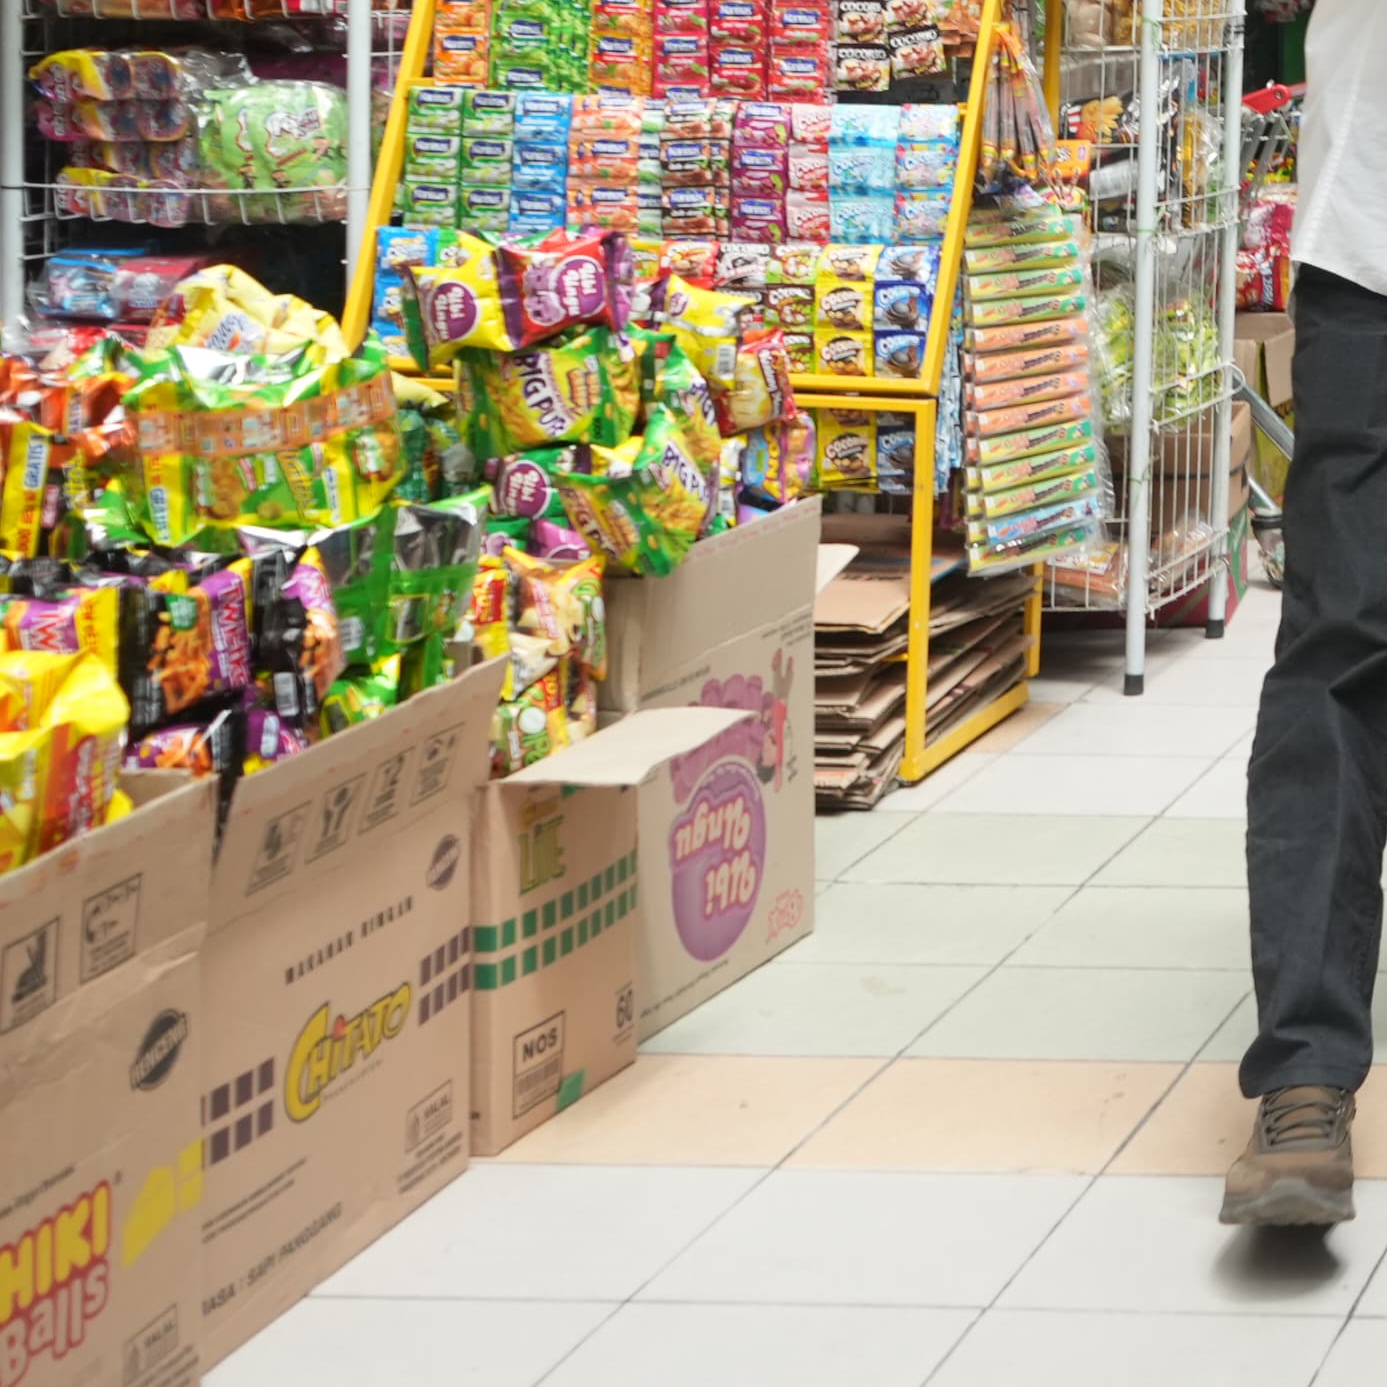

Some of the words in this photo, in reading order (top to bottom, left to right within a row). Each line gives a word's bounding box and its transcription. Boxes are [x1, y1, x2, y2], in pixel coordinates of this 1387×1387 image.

[674, 798, 751, 865] Ungu
[704, 853, 757, 916] Ubi
[616, 988, 634, 1030] 60
[522, 1027, 559, 1063] NOS
[0, 1251, 109, 1387] Balls
